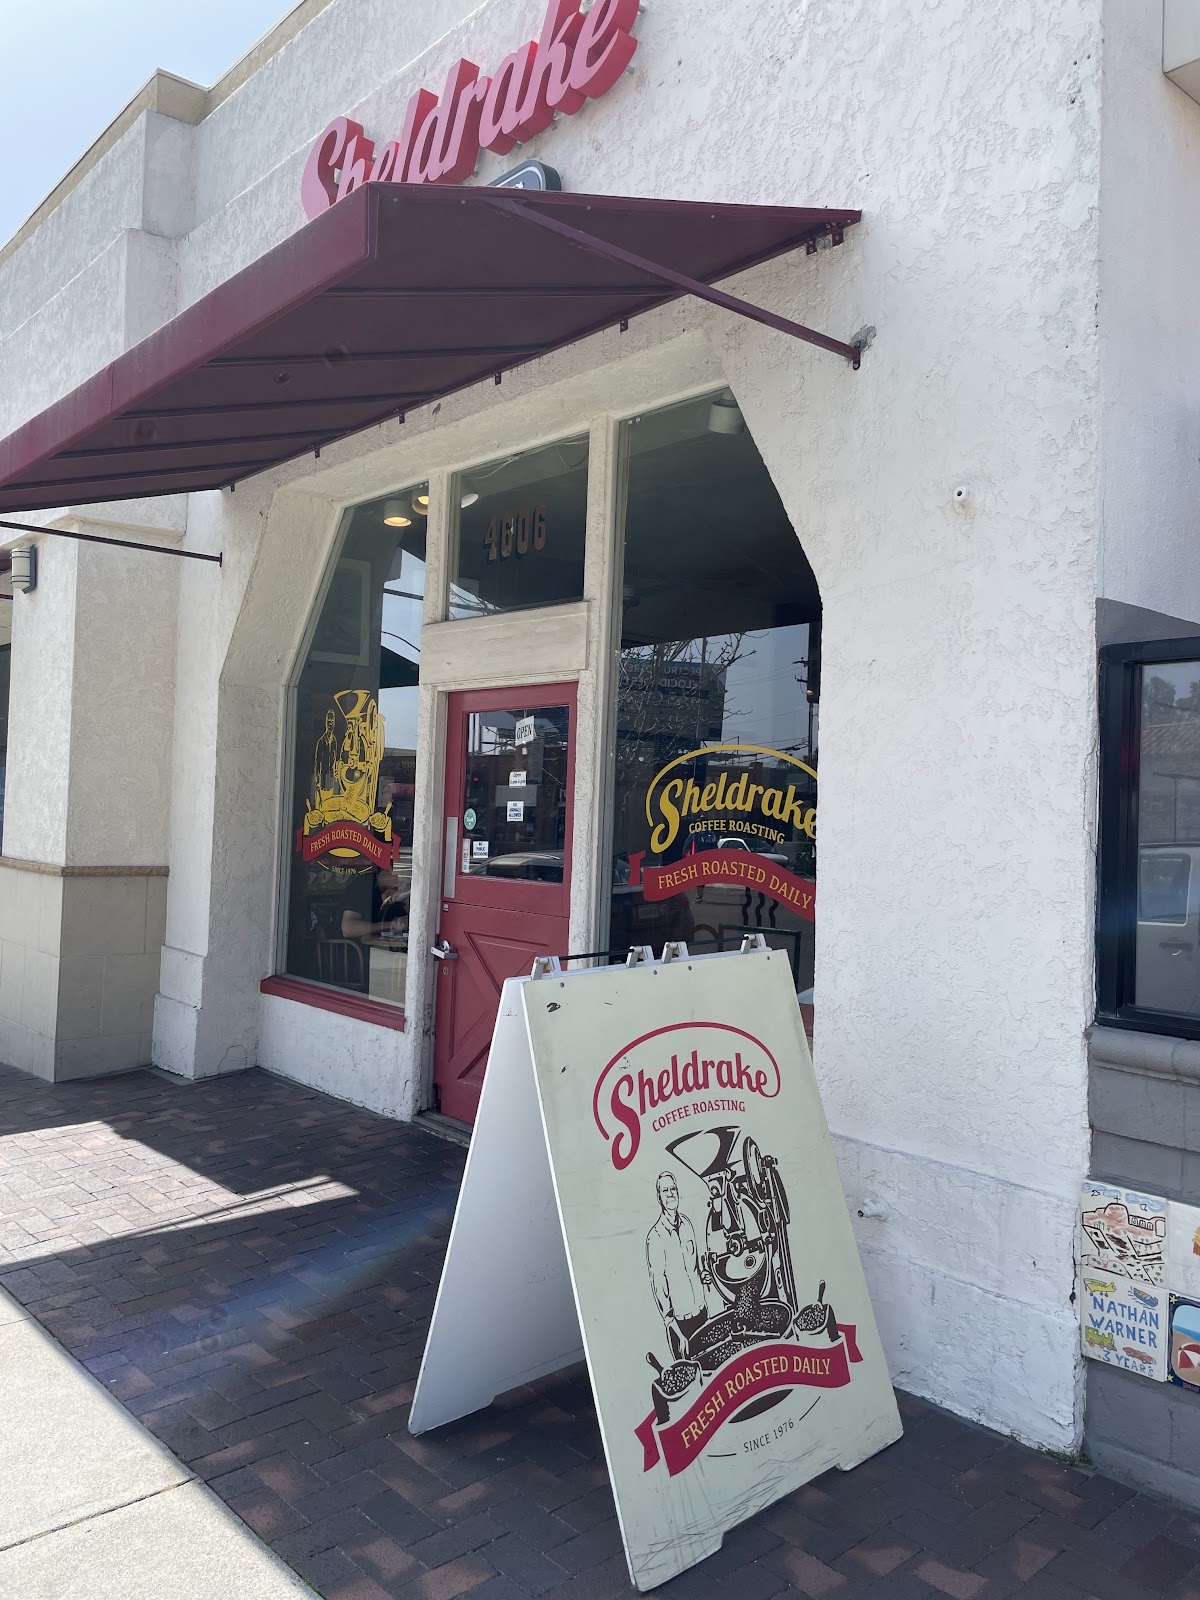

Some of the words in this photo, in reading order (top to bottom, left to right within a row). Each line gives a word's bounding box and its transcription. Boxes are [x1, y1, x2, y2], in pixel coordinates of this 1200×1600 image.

[301, 0, 638, 218] Sheldrake
[516, 724, 532, 739] OPEN
[651, 772, 816, 853] Sheldrake
[310, 833, 330, 852] FRESH
[332, 830, 361, 843] ROASTED
[363, 837, 382, 858] DAILY
[689, 820, 726, 834] COFFEE
[729, 820, 785, 845] ROASTING
[657, 864, 699, 890] FRESH
[702, 861, 766, 884] ROASTED
[768, 875, 813, 909] DAILY
[610, 1050, 768, 1171] Sheldrake
[652, 1105, 691, 1132] COFFEE
[691, 1099, 746, 1115] ROASTING
[1092, 1296, 1159, 1329] NATHAN
[1088, 1313, 1158, 1349] WARNER
[1102, 1349, 1111, 1362] 3
[680, 1390, 726, 1449] FRESH
[724, 1355, 789, 1399] ROASTED
[792, 1355, 831, 1375] DAILY
[743, 1435, 771, 1453] SINCE
[773, 1417, 795, 1440] 1976
